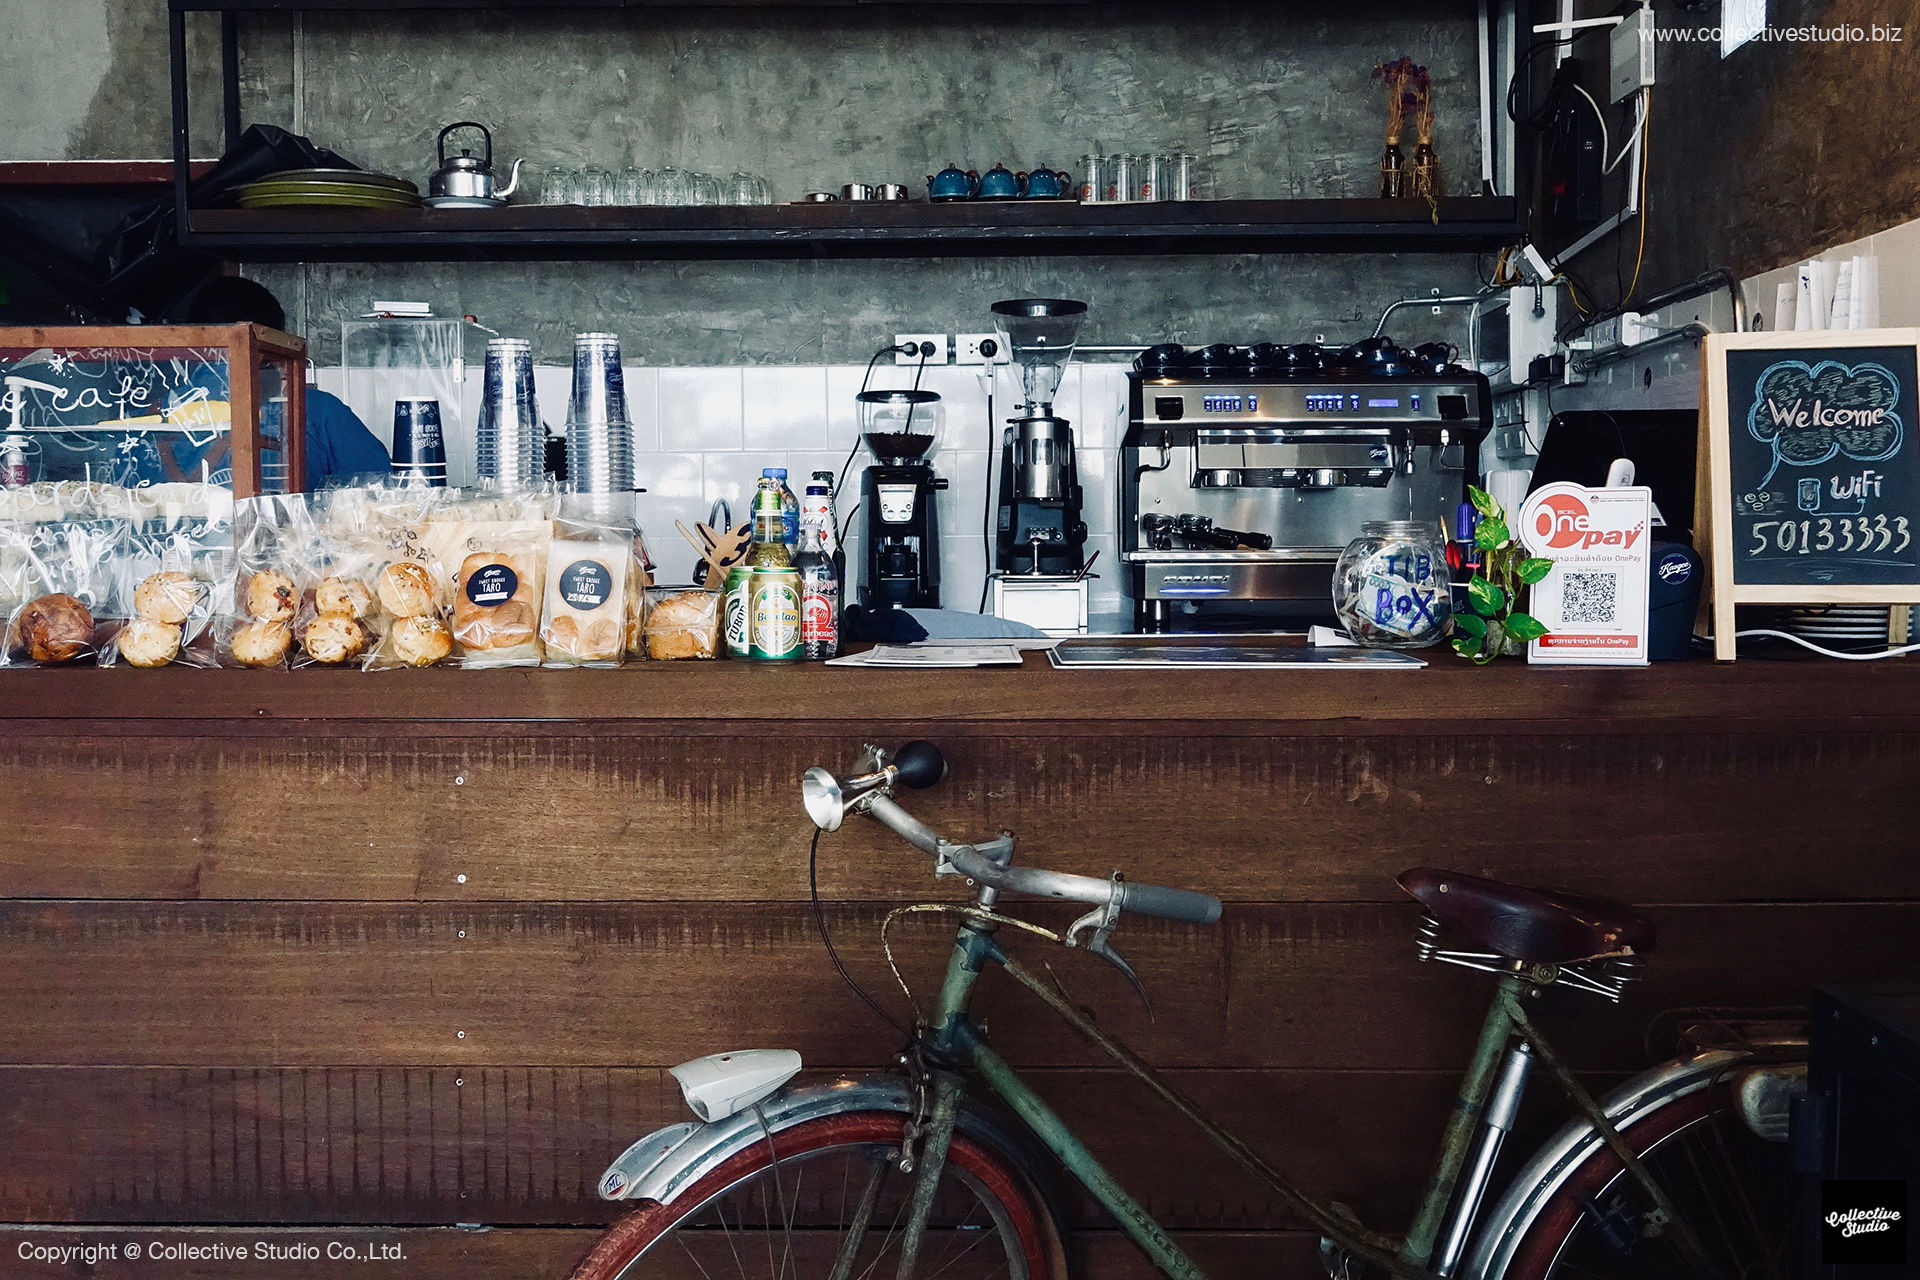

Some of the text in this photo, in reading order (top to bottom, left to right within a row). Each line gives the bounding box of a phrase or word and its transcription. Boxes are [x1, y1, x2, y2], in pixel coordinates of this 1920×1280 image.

[1768, 398, 1884, 428] Welcome
[1532, 504, 1590, 546] One
[1750, 513, 1910, 555] 50133333
[1581, 530, 1642, 550] pay
[482, 582, 501, 593] TARO
[576, 582, 595, 595] TARO
